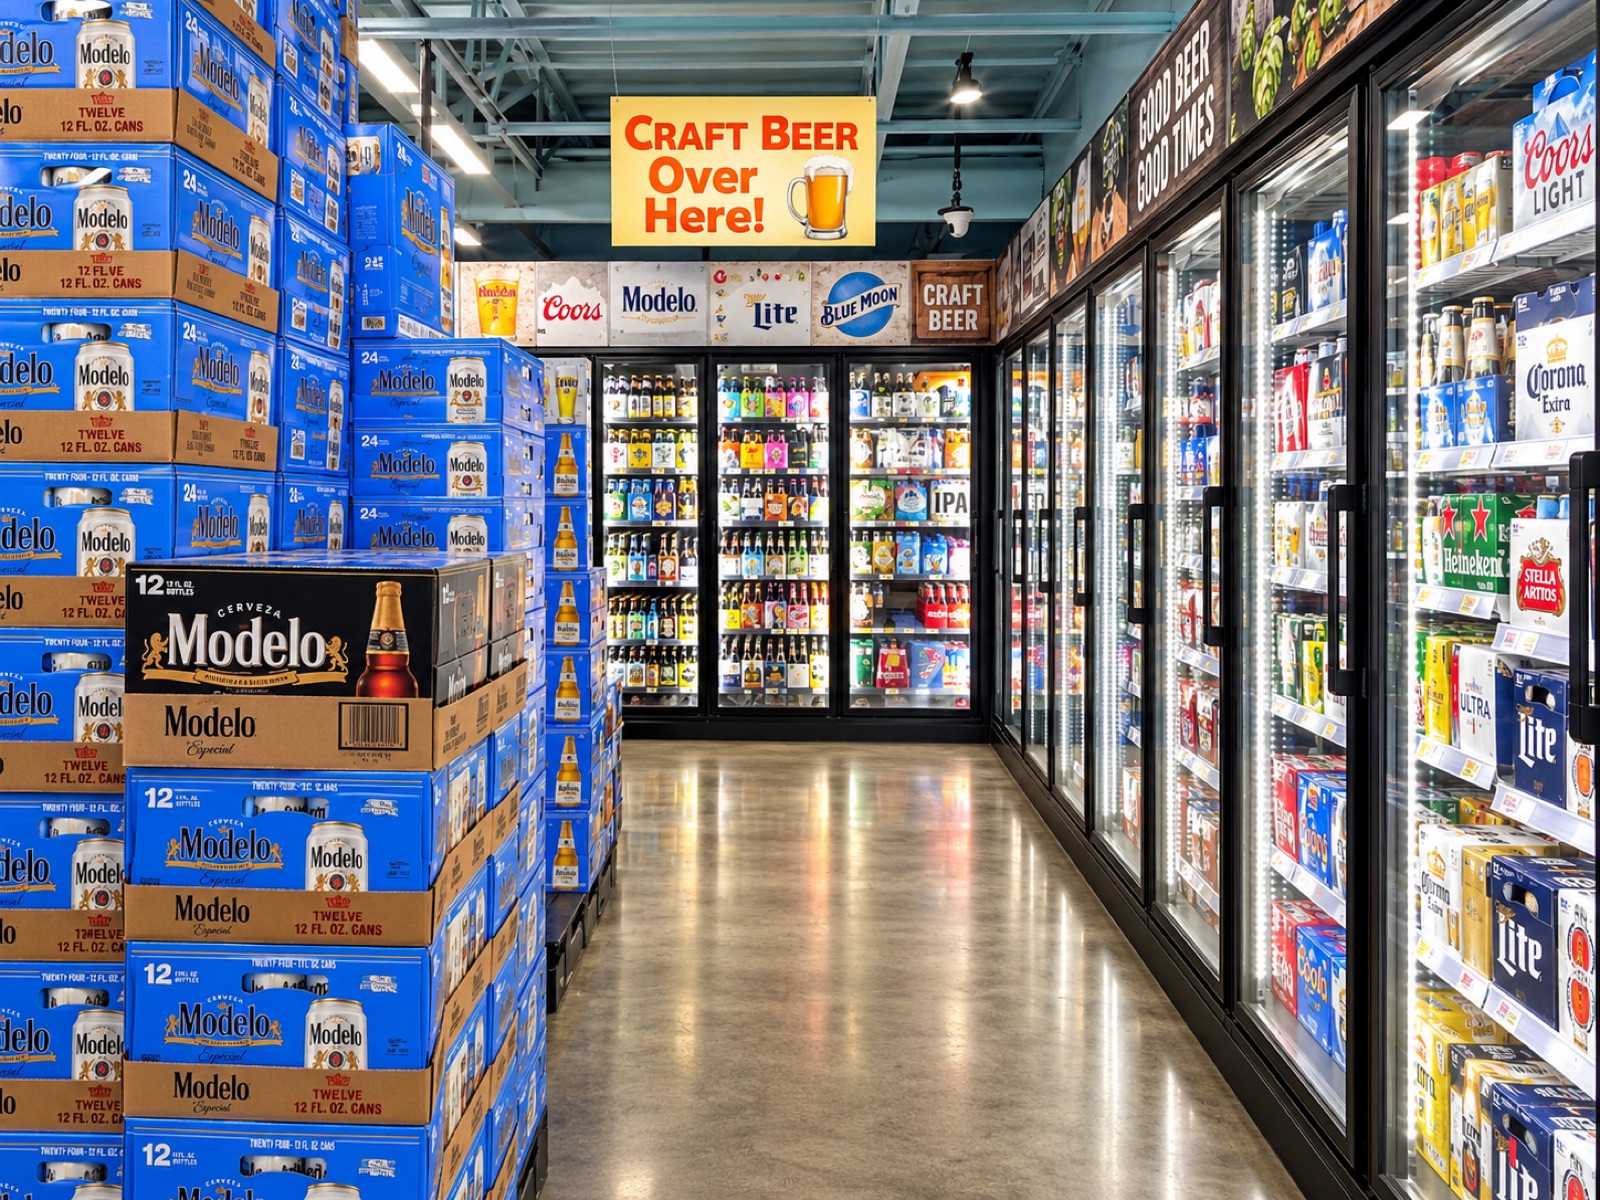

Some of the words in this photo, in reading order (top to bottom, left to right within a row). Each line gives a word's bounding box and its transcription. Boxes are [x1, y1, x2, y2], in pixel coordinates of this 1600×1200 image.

[185, 11, 199, 37] 24
[0, 31, 53, 64] delo
[80, 43, 131, 66] Modelo
[1138, 68, 1171, 150] GOOD
[1175, 19, 1211, 112] BEER
[78, 107, 126, 118] TWELVE
[60, 121, 73, 132] 12
[76, 120, 92, 132] FL.
[94, 120, 112, 132] OZ.
[114, 120, 144, 132] CANS
[624, 114, 749, 151] CRAFT
[761, 115, 859, 150] BEER
[1137, 135, 1169, 212] GOOD
[1172, 84, 1215, 178] TIMES
[1524, 123, 1595, 190] Coors
[183, 169, 197, 192] 24
[648, 156, 758, 194] Over
[1533, 170, 1585, 216] LIGHT
[0, 197, 52, 230] delo
[77, 207, 128, 230] Modelo
[645, 197, 765, 234] Here!
[60, 278, 73, 289] 12
[76, 277, 92, 289] FL.
[93, 277, 110, 289] OZ.
[113, 277, 142, 289] CANS
[820, 302, 857, 327] BLUE
[861, 286, 898, 310] MOON
[923, 283, 984, 307] CRAFT
[543, 294, 603, 321] Coors
[753, 302, 797, 330] Lite
[183, 322, 197, 341] 24
[928, 309, 979, 331] BEER
[0, 353, 53, 386] delo
[199, 345, 240, 388] Modelo
[362, 352, 378, 364] 24
[79, 364, 130, 388] Modelo
[380, 369, 434, 390] Modelo
[450, 374, 484, 388] Modelo
[1526, 363, 1587, 402] Corona
[78, 430, 125, 440] TWELVE
[361, 435, 378, 447] 24
[60, 442, 73, 453] 12
[76, 442, 92, 453] FL.
[93, 442, 111, 453] OZ.
[113, 442, 142, 453] CANS
[380, 453, 434, 473] Modelo
[450, 458, 484, 472] Modelo
[183, 483, 197, 503] 24
[934, 492, 968, 514] IPA
[198, 506, 239, 539] Modelo
[360, 508, 378, 520] 24
[0, 516, 56, 550] delo
[82, 531, 131, 553] Modelo
[379, 525, 434, 547] Modelo
[450, 530, 485, 546] Modelo
[135, 574, 164, 596] 12
[1524, 568, 1557, 586] STELLA
[79, 595, 125, 606] TWELVE
[217, 602, 282, 619] CERVEZA
[62, 608, 74, 619] 12
[77, 608, 93, 619] FL.
[95, 608, 111, 619] OZ.
[168, 613, 327, 668] Modelo
[0, 683, 52, 717] delo
[79, 696, 123, 718] Model
[1461, 692, 1492, 720] ULTRA
[165, 705, 256, 738] Modelo
[186, 740, 235, 760] Especial
[1517, 711, 1557, 769] Lite
[63, 760, 108, 771] TWELVE
[44, 773, 57, 784] 12
[60, 773, 76, 784] FL.
[78, 773, 96, 784] OZ.
[144, 788, 173, 808] 12
[180, 827, 271, 860] Modelo
[0, 849, 51, 884] delo
[311, 846, 362, 869] Modelo
[175, 895, 250, 923] Modelo
[313, 911, 362, 922] TWELVE
[294, 923, 308, 935] 12
[311, 923, 327, 935] FL.
[330, 923, 348, 935] OZ.
[351, 924, 382, 936] CANS
[57, 941, 70, 952] 12
[73, 941, 88, 952] FL.
[91, 941, 108, 952] OZ.
[1497, 916, 1543, 982] Lite
[144, 963, 172, 984] 12
[178, 1002, 270, 1037] Modelo
[0, 1018, 49, 1053] delo
[309, 1023, 361, 1046] Modelo
[173, 1071, 250, 1100] Modelo
[313, 1089, 362, 1101] TWELVE
[75, 1100, 122, 1110] TWELVE
[294, 1102, 307, 1114] 12
[310, 1102, 327, 1114] FL.
[329, 1102, 348, 1114] OZ.
[351, 1103, 382, 1115] CANS
[57, 1113, 70, 1124] 12
[73, 1113, 89, 1124] FL.
[91, 1113, 108, 1124] OZ.
[142, 1143, 171, 1166] 12
